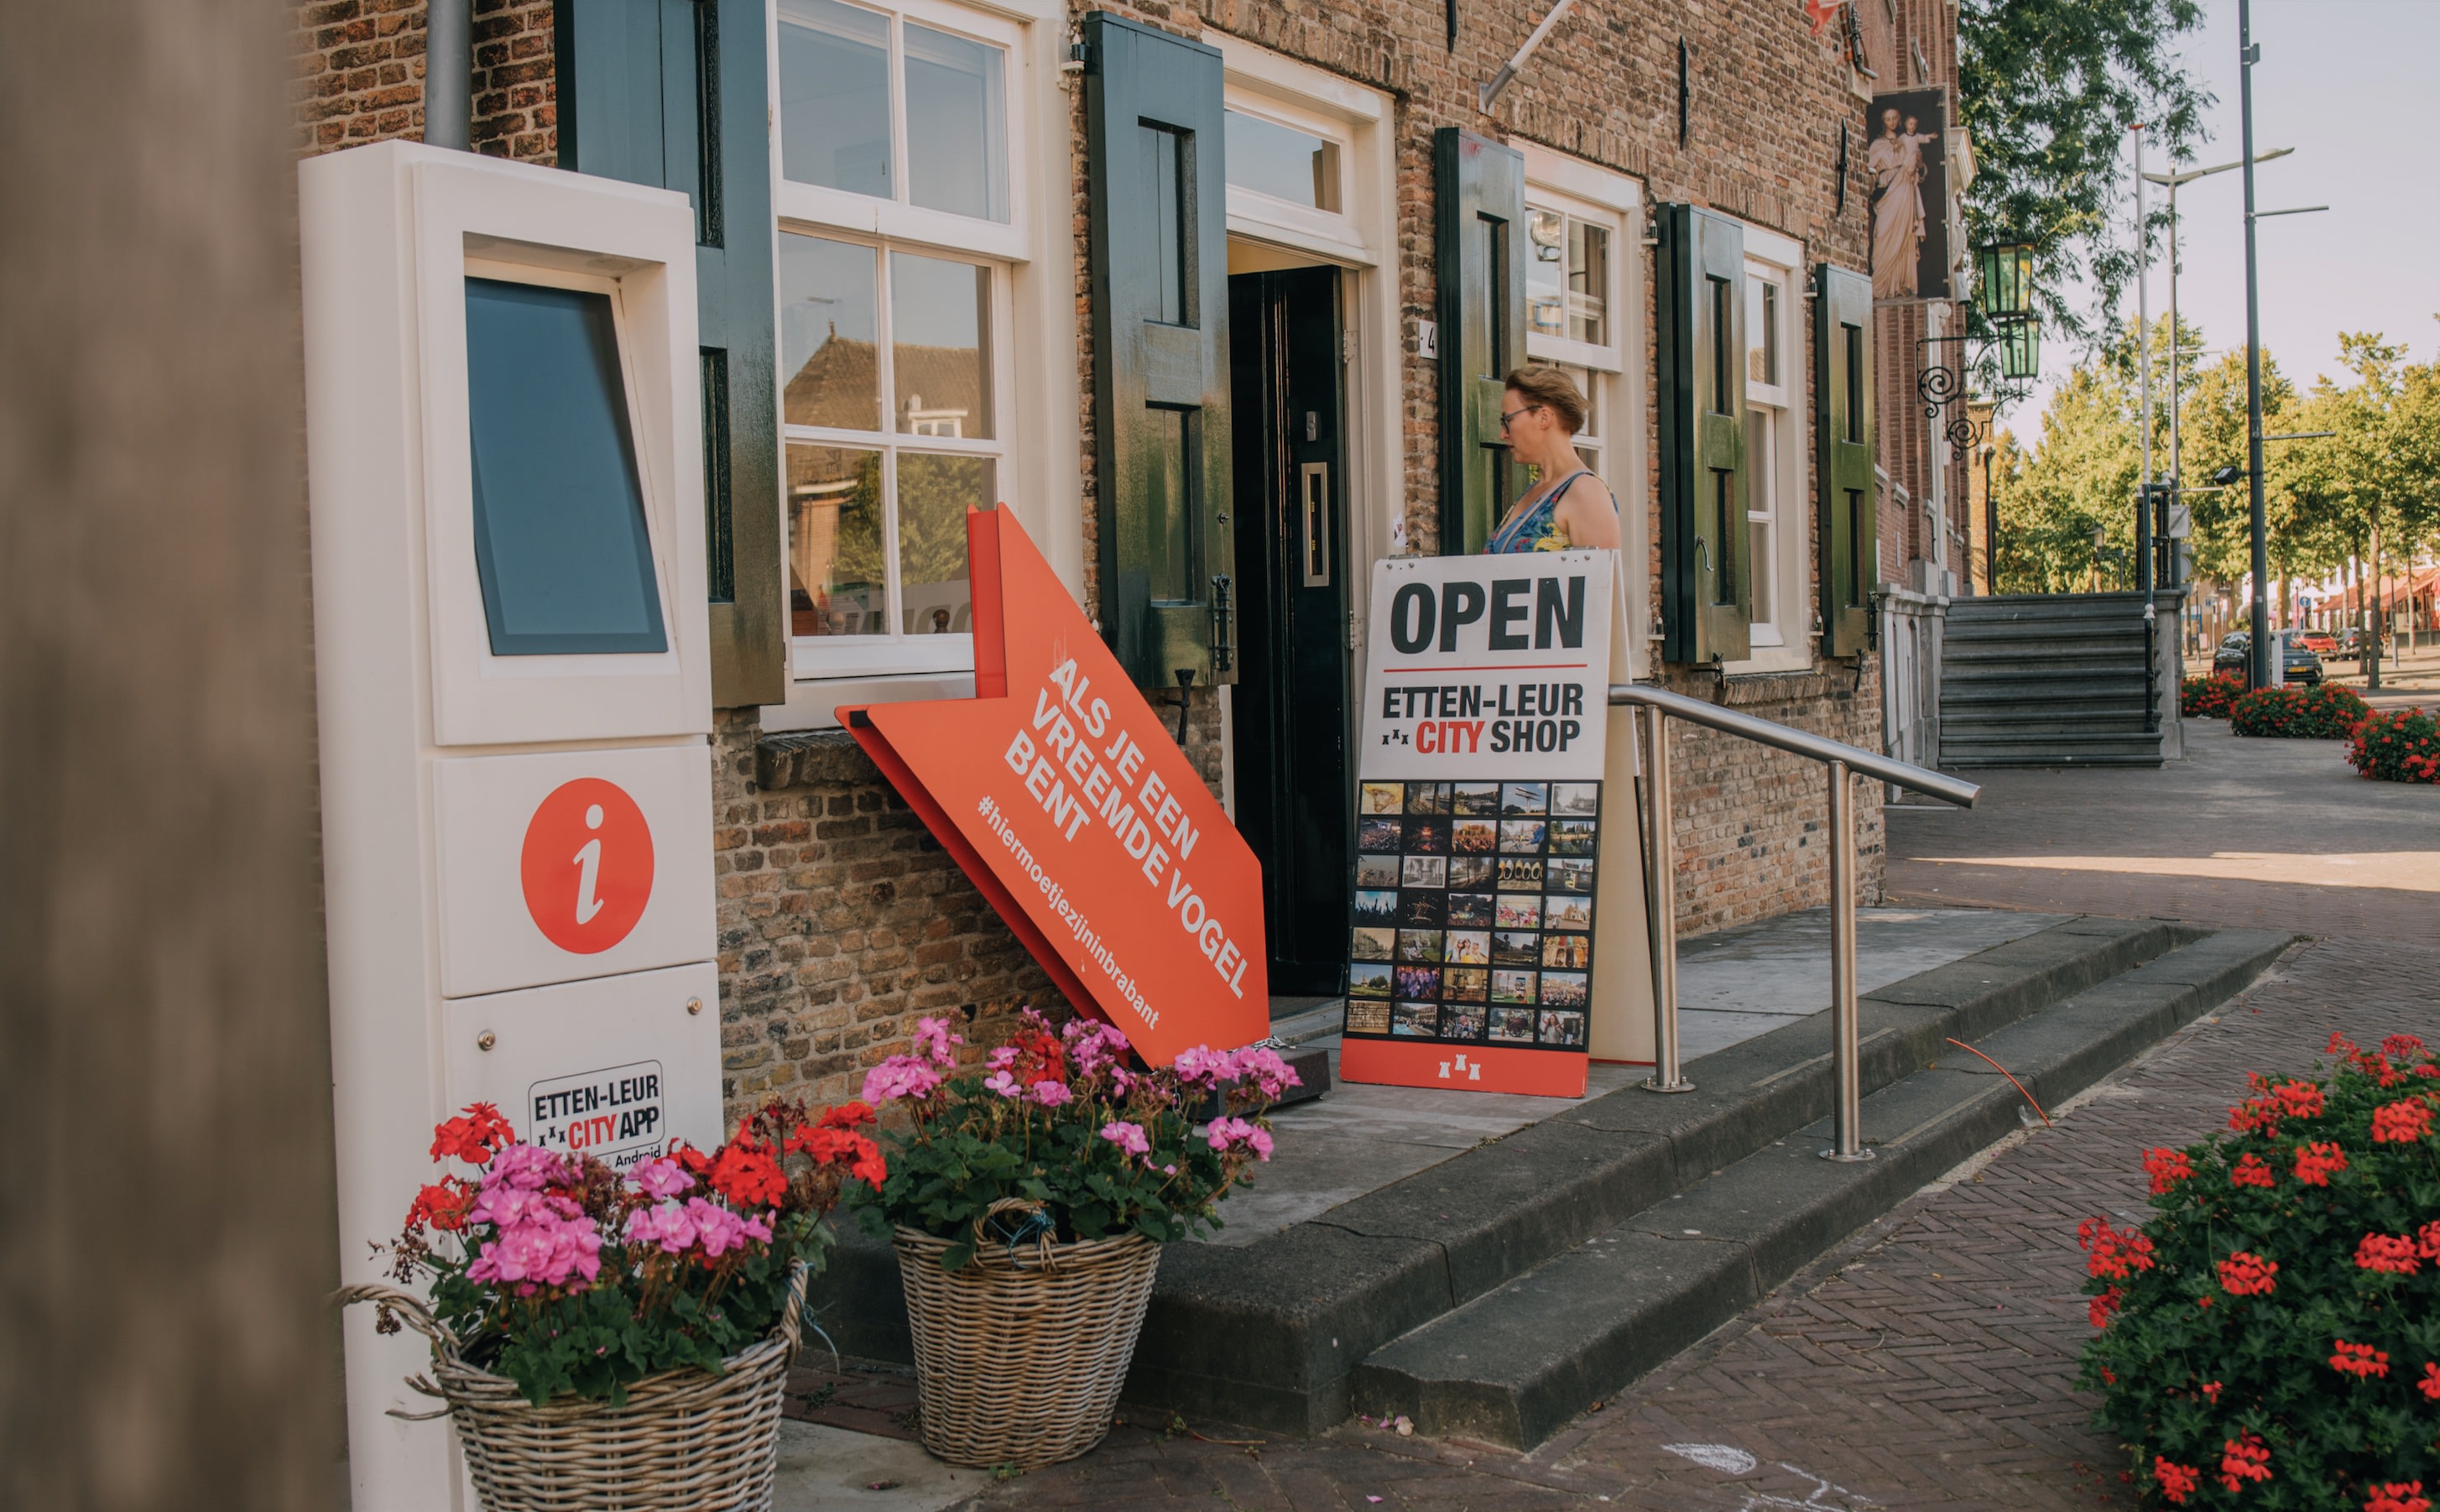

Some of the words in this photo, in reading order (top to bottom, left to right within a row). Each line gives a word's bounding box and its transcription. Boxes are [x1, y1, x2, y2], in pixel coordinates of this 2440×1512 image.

[1390, 576, 1586, 654] OPEN
[1383, 683, 1583, 718] ETTEN-LEUR
[1416, 721, 1485, 753] CITY
[1490, 720, 1580, 753] SHOP
[1004, 729, 1092, 842] BENT
[1049, 658, 1111, 738] ALS
[1104, 729, 1144, 786] JE
[1138, 770, 1199, 860] EEN
[1032, 687, 1170, 887] VREEMDE
[1166, 868, 1249, 999] VOGEL
[978, 795, 1160, 1030] #hiermoetjezijninbrabant
[534, 1074, 659, 1121] ETTEN-LEUR
[568, 1113, 618, 1150] CITY
[619, 1106, 660, 1139] APP
